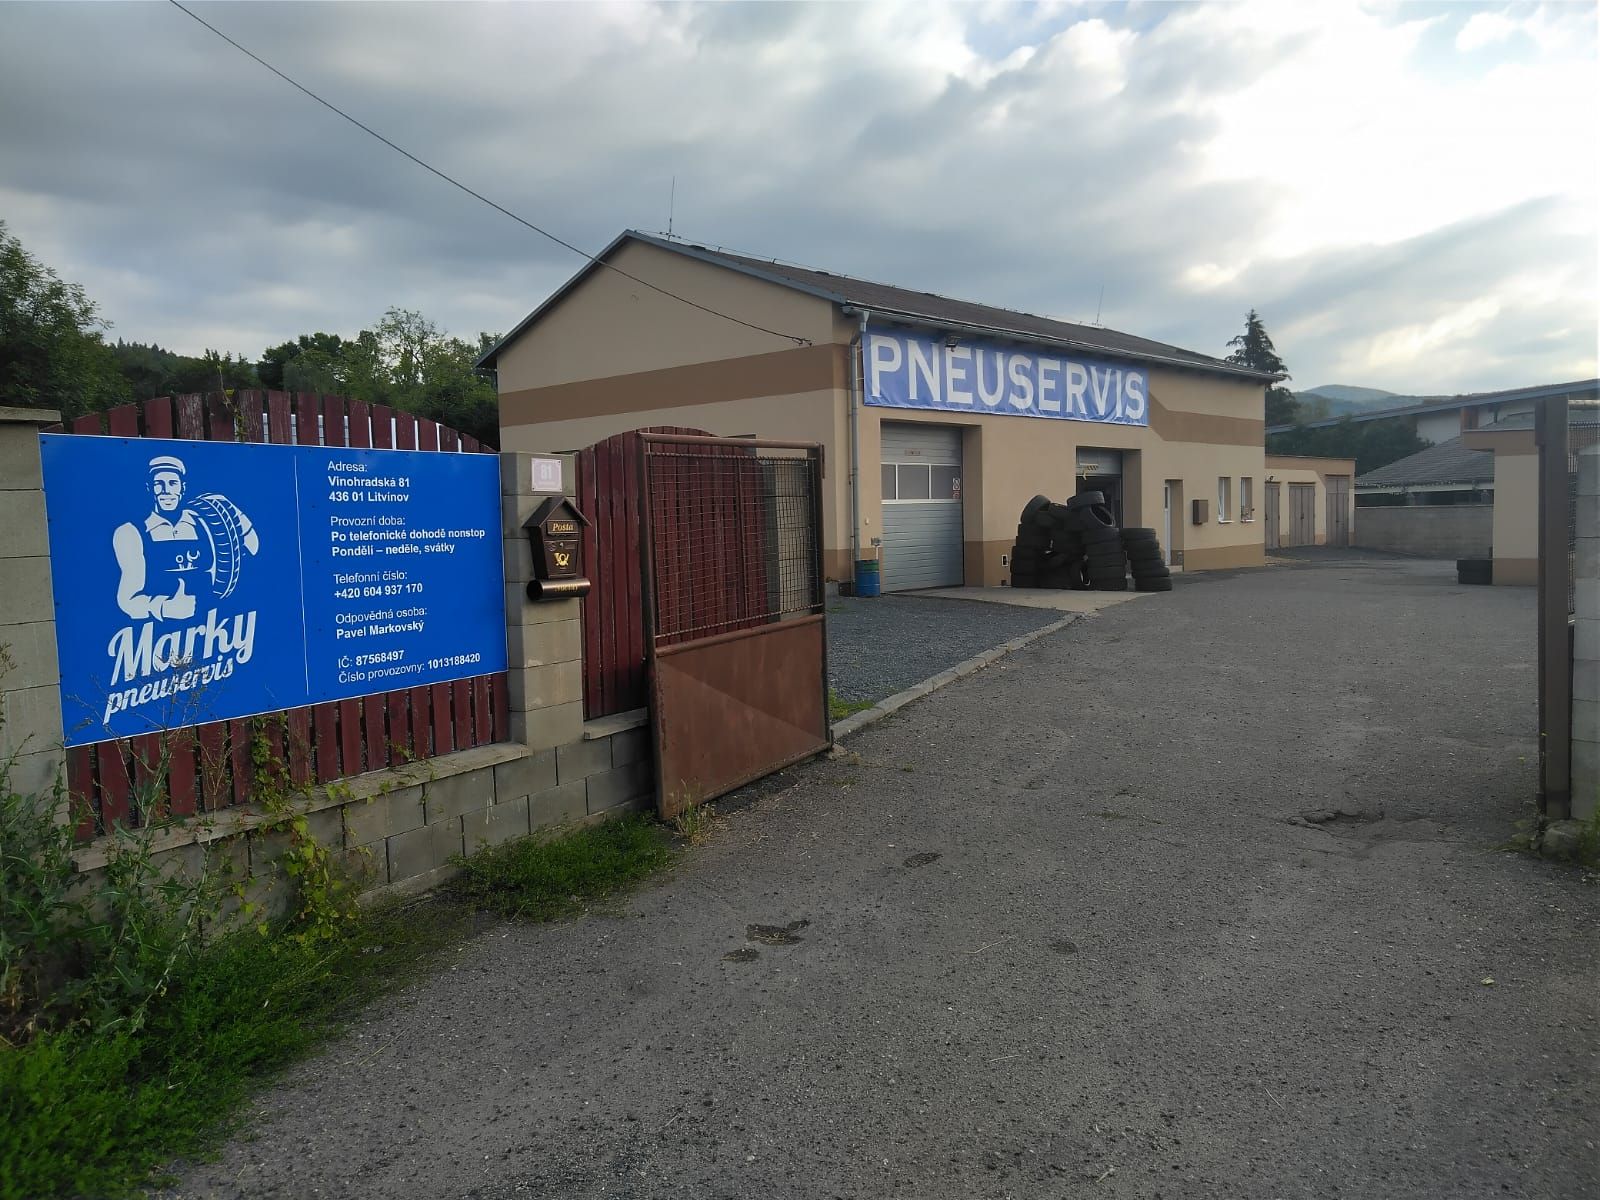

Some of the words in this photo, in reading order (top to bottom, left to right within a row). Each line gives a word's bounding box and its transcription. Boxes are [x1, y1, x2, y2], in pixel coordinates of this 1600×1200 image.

[870, 335, 1145, 419] PNEUSERVIS
[328, 461, 367, 472] Adresa:
[328, 476, 396, 487] Vinohradská
[399, 478, 410, 487] 81
[329, 492, 349, 501] 436
[352, 492, 363, 501] 01
[368, 492, 409, 502] Litvínov
[330, 516, 375, 526] Provozní
[379, 516, 405, 525] doba:
[332, 532, 346, 541] Po
[350, 530, 406, 541] telefonické
[410, 529, 445, 539] dohodě
[448, 529, 485, 539] nonstop
[332, 545, 374, 556] Pondělí
[386, 544, 422, 555] neděle,
[425, 543, 454, 553] svátky
[333, 573, 380, 584] Telefonní
[382, 571, 407, 581] číslo:
[334, 588, 360, 599] +420
[364, 586, 382, 596] 604
[385, 585, 402, 595] 937
[406, 583, 422, 593] 170
[336, 610, 393, 625] Odpovědná
[397, 607, 427, 617] osoba:
[337, 627, 366, 639] Pavel
[370, 620, 424, 636] Markovský
[108, 608, 256, 686] Marky
[338, 656, 352, 668] IČ:
[356, 650, 404, 665] 87568497
[338, 672, 365, 683] Číslo
[368, 663, 424, 681] provozovny:
[428, 653, 480, 669] 1013188420
[103, 656, 233, 725] pneuservis
